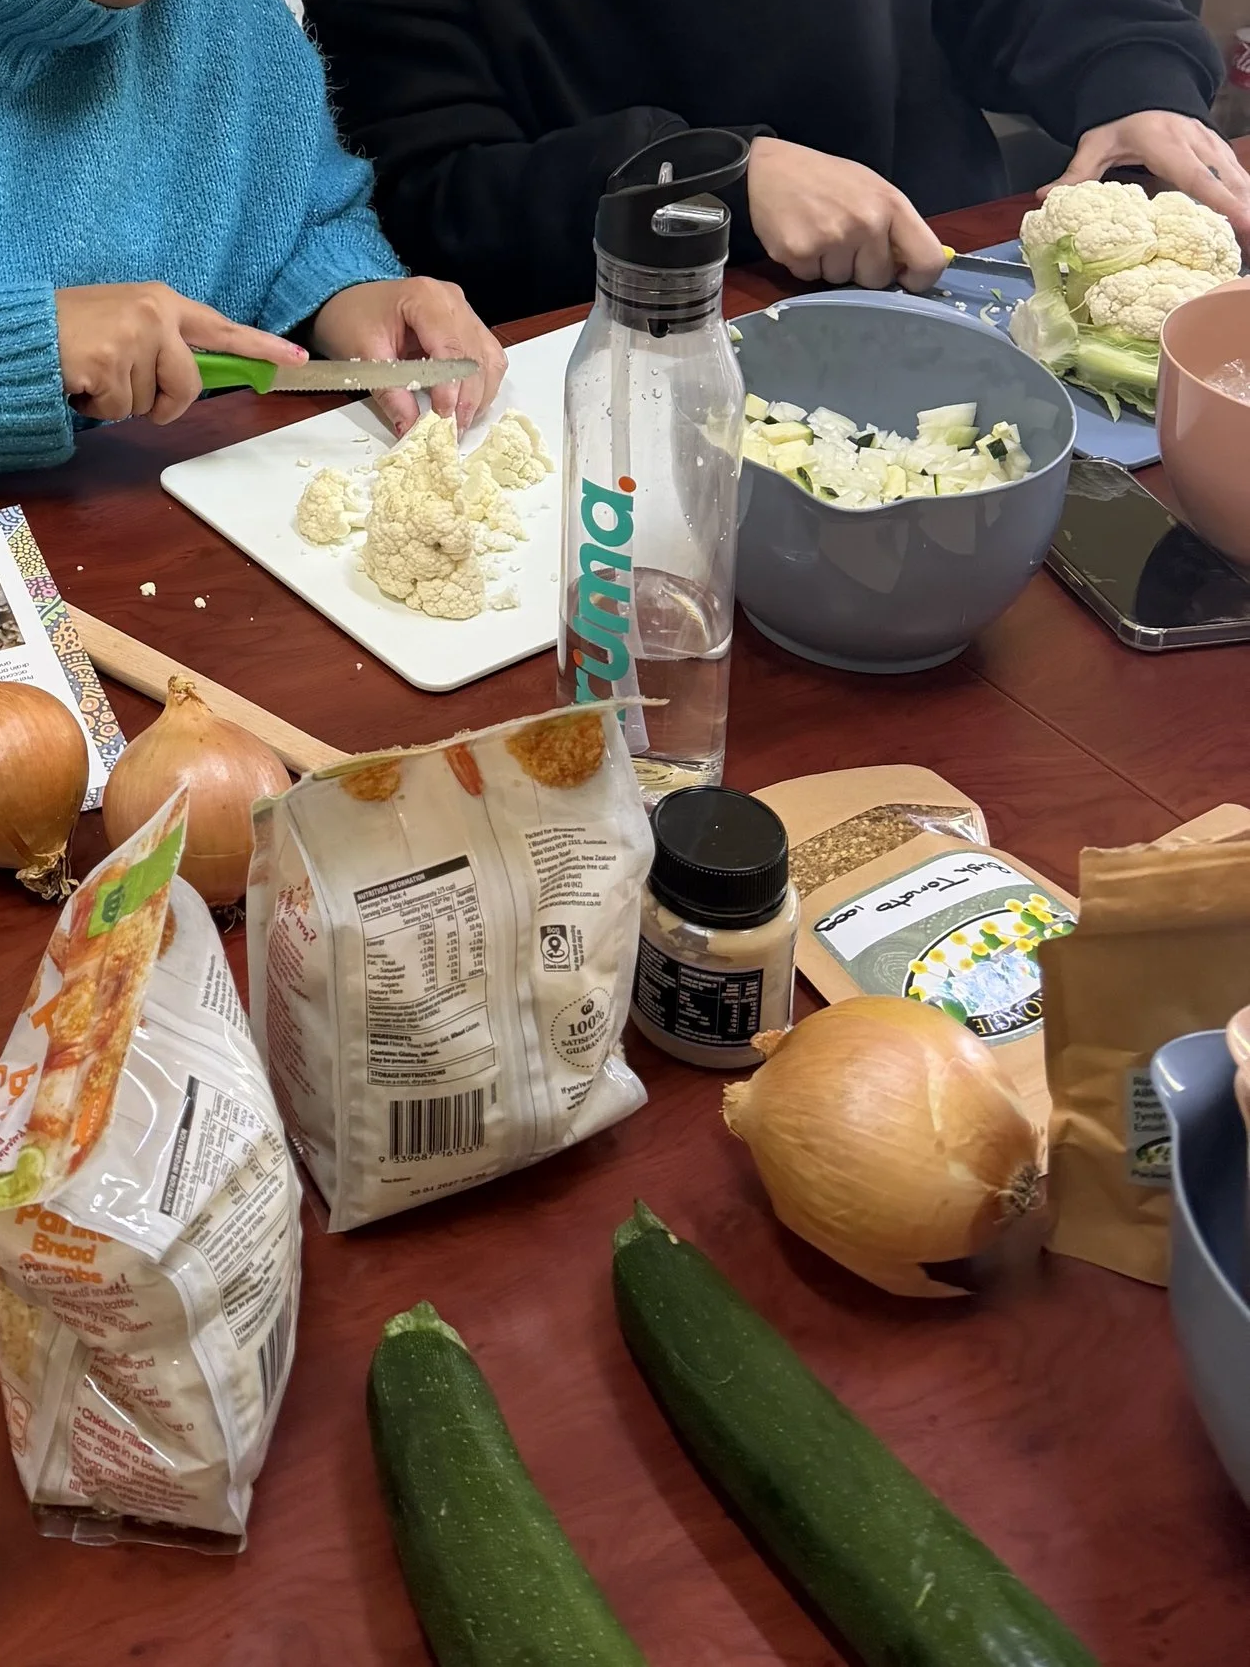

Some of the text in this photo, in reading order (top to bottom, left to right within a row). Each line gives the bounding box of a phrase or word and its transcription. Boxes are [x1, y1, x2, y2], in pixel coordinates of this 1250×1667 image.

[357, 873, 426, 901] NUTRITION INFORMATION
[813, 861, 1012, 933] Bush Tomato 100g
[359, 900, 380, 911] Servings
[380, 897, 389, 905] Per
[568, 1006, 605, 1038] 100%
[370, 1033, 412, 1042] INGREDIENTS
[370, 1068, 447, 1079] STORAGE INSTRUCTIONS
[163, 1128, 188, 1212] NUTRITION INFORMATION
[378, 1155, 386, 1163] 9
[30, 1231, 99, 1264] Bread
[72, 1417, 97, 1434] Beat
[97, 1433, 121, 1455] eggs
[81, 1407, 122, 1438] Chicken
[72, 1429, 92, 1449] Toss
